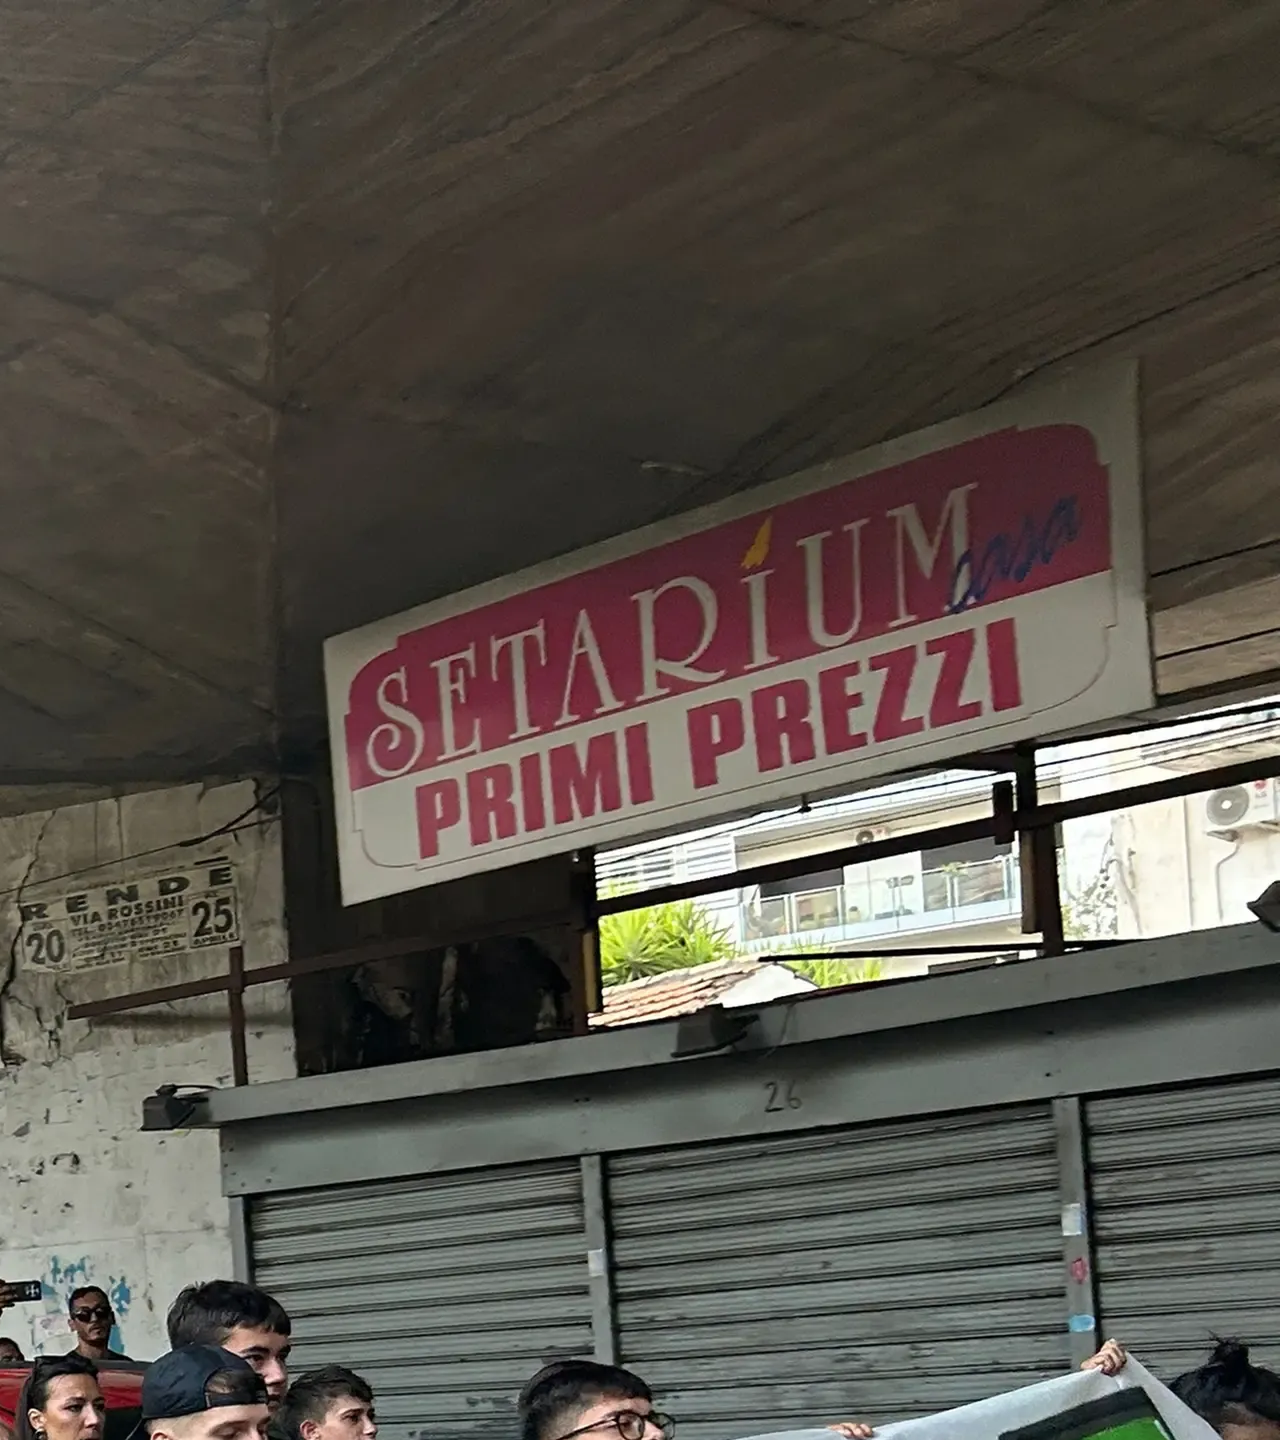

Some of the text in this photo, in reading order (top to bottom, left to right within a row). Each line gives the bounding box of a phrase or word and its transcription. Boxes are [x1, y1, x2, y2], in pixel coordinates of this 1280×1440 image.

[415, 617, 1025, 860] PRIMI PREZZI
[20, 865, 234, 922] RENDE
[70, 911, 102, 927] VIA
[107, 895, 185, 921] ROSSINI
[191, 896, 234, 938] 25
[25, 929, 65, 965] 20
[763, 1079, 803, 1114] 26
